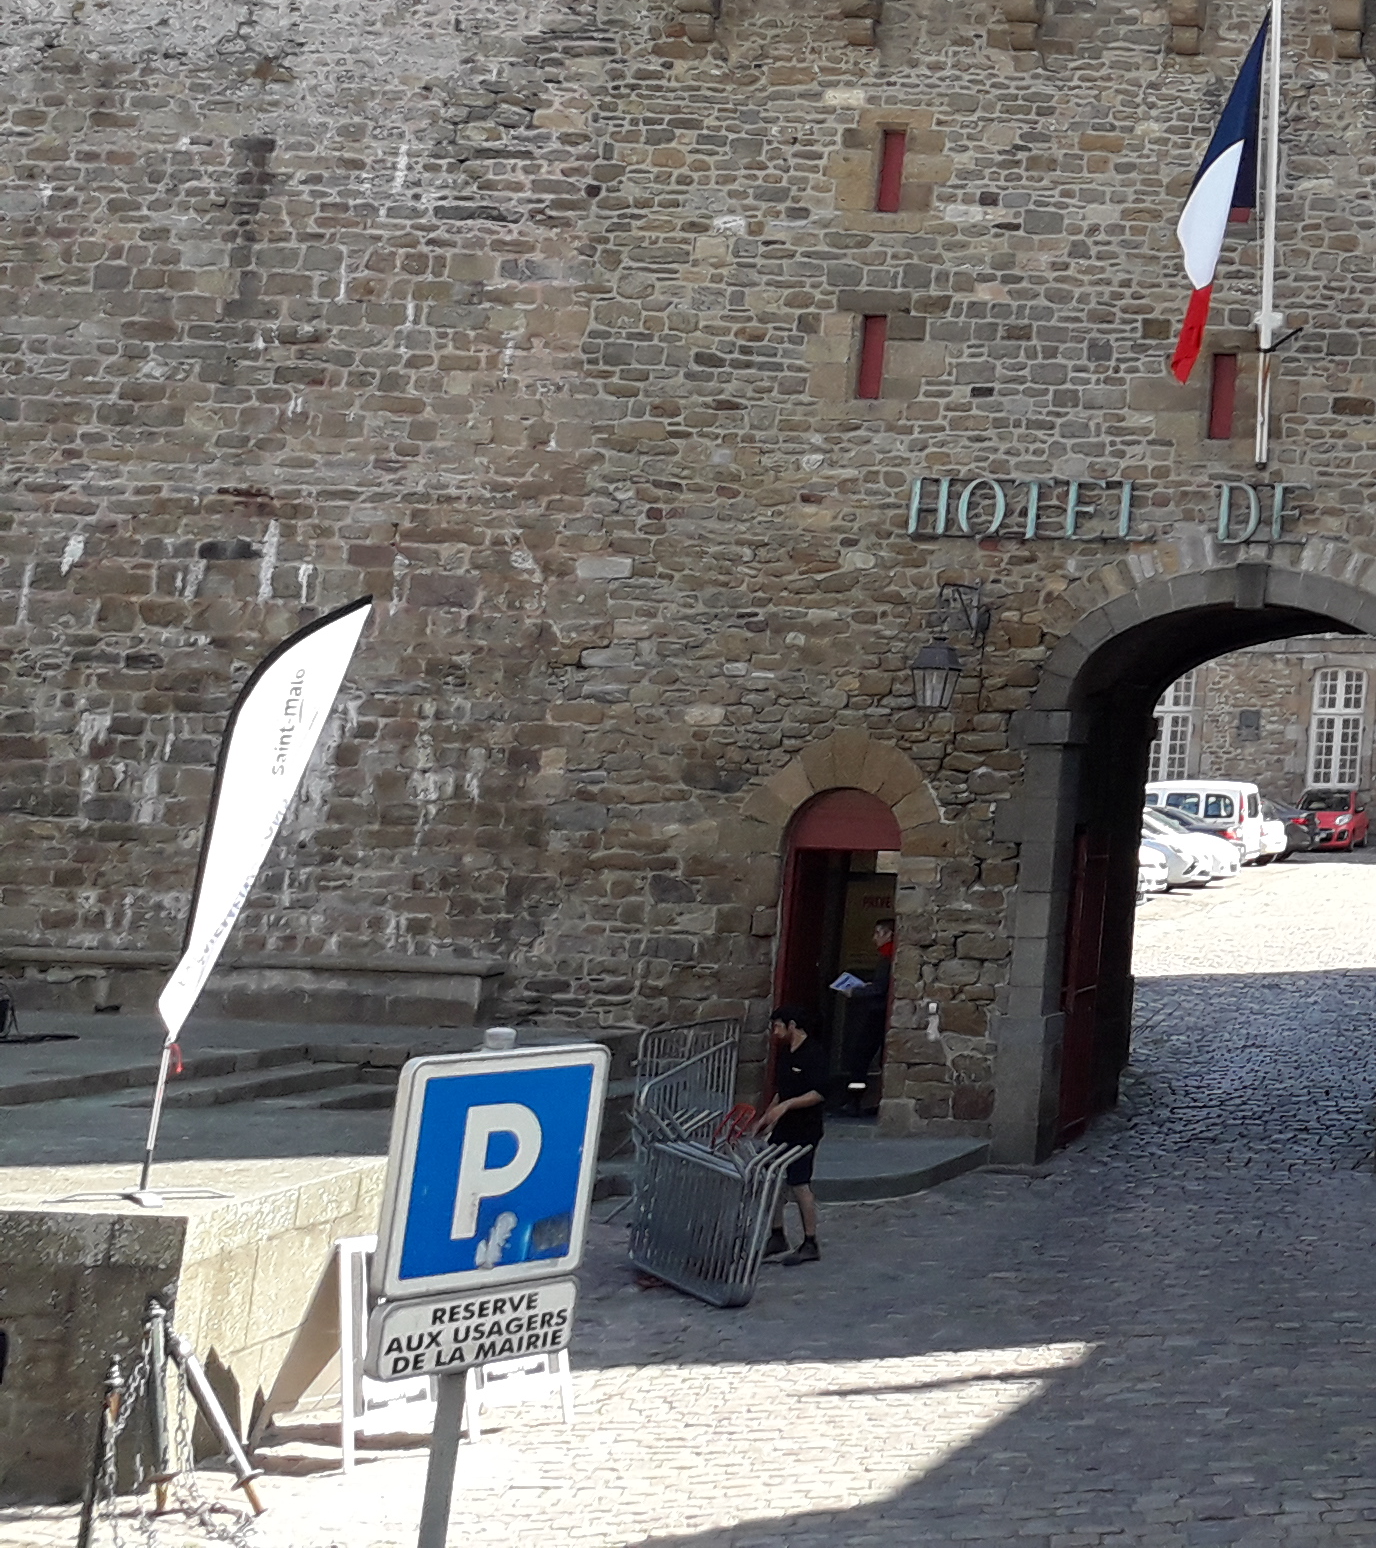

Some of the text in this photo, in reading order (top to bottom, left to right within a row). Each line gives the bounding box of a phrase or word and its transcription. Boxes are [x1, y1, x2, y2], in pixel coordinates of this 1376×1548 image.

[906, 477, 1154, 540] HOTEL
[1216, 481, 1312, 544] DE
[451, 1103, 542, 1240] P
[384, 1308, 568, 1357] AUX USAGERS
[431, 1292, 540, 1326] RESERVE
[391, 1328, 563, 1376] DE LA MAIRIE
